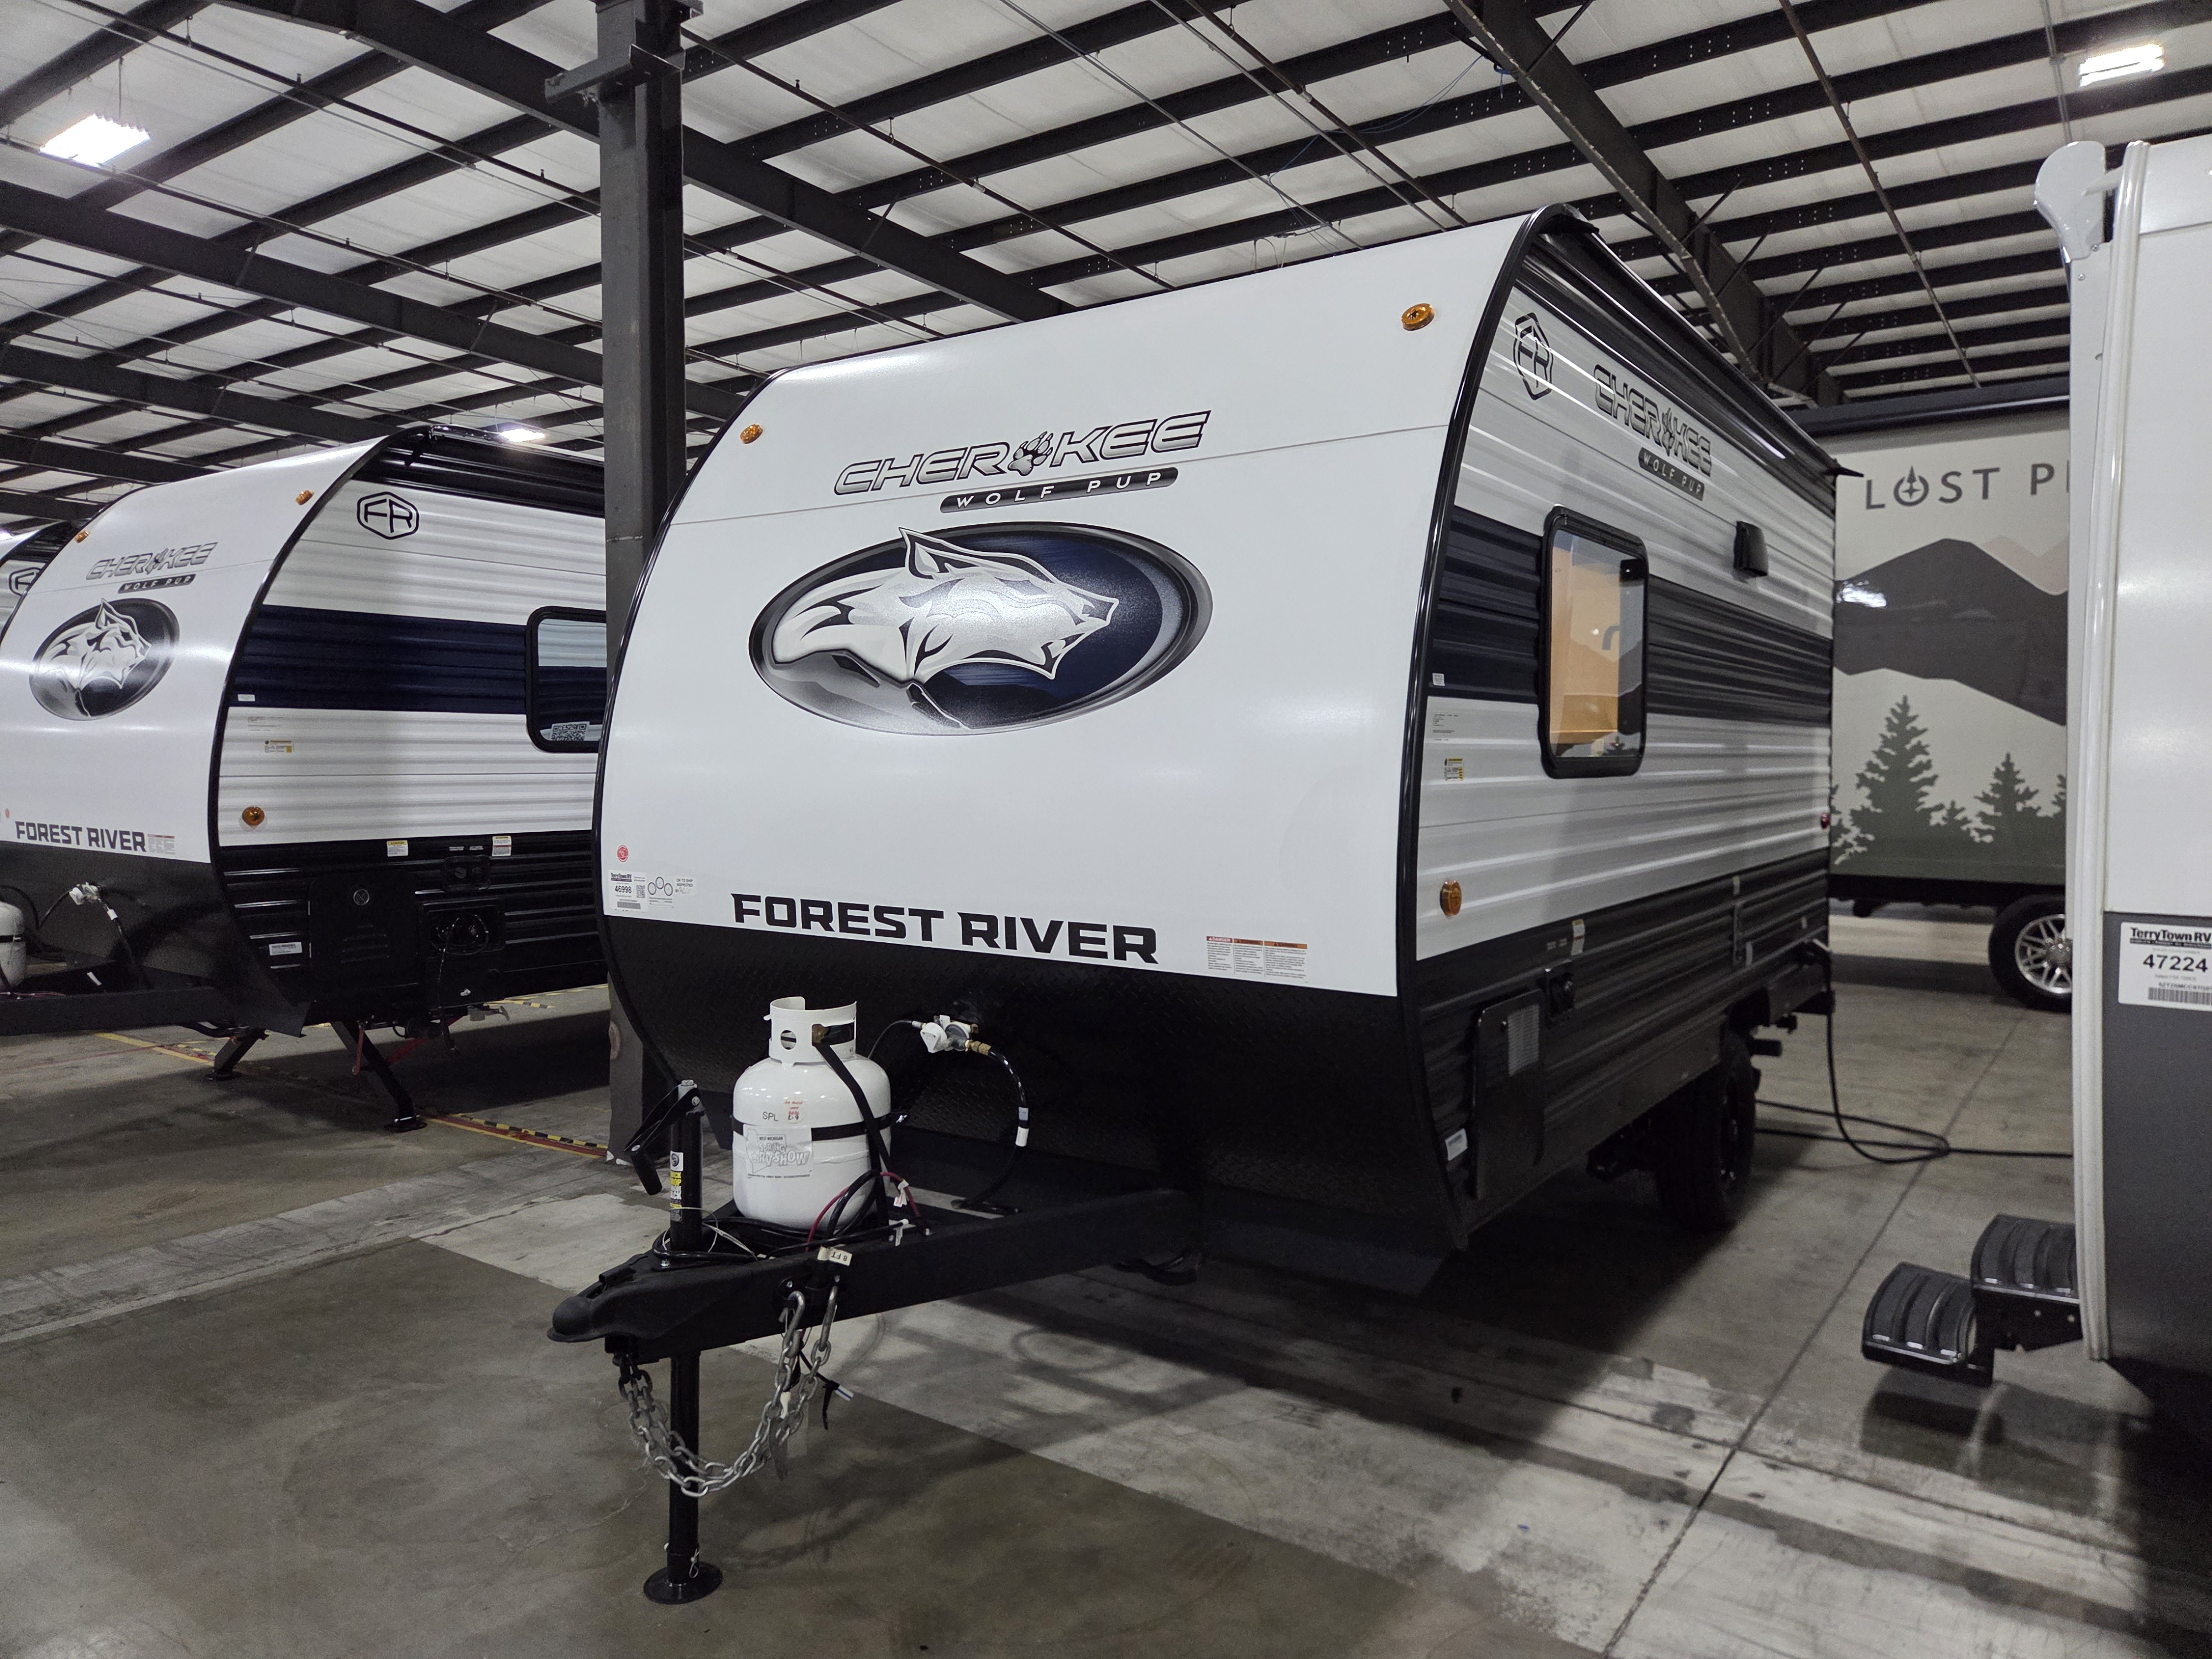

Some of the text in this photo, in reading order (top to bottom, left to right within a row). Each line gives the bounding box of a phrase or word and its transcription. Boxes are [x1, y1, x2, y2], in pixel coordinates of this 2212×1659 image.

[1643, 451, 1702, 496] WOLF PUP
[956, 472, 1162, 510] WOLF PUP
[1865, 466, 2000, 510] LOST
[123, 576, 191, 591] WOLF PUP
[15, 821, 82, 845] FOREST
[86, 827, 147, 852] RIVER
[614, 885, 632, 894] 46998
[731, 893, 945, 942] FOREST
[957, 911, 1159, 964] RIVER
[2130, 927, 2211, 942] TerryTown RV
[2142, 953, 2208, 972] 47224
[762, 1111, 779, 1122] SPL
[759, 1142, 786, 1154] SPRING
[831, 1251, 841, 1260] FT
